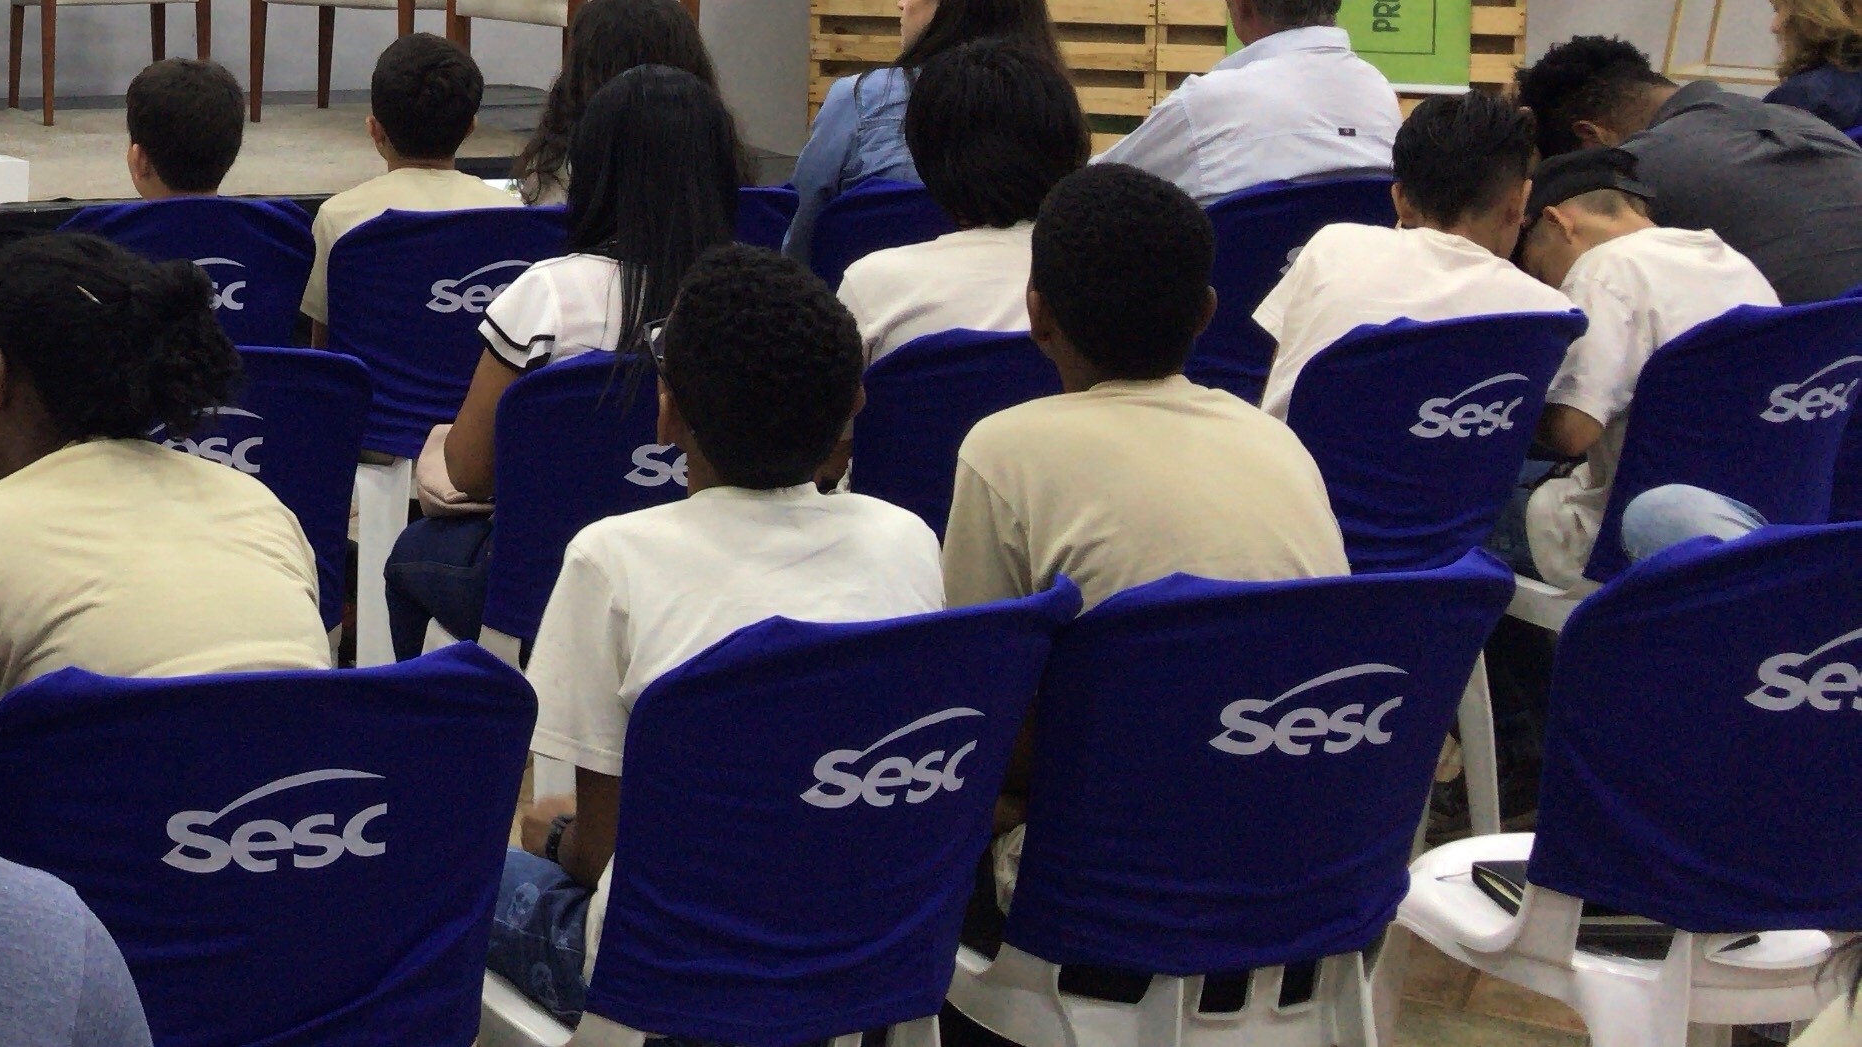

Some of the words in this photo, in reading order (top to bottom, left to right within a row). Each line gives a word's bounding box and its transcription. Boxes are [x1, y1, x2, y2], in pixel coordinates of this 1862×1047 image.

[1208, 696, 1403, 755] Sesc
[799, 739, 978, 809] Sesc
[161, 803, 388, 873] Sesc
